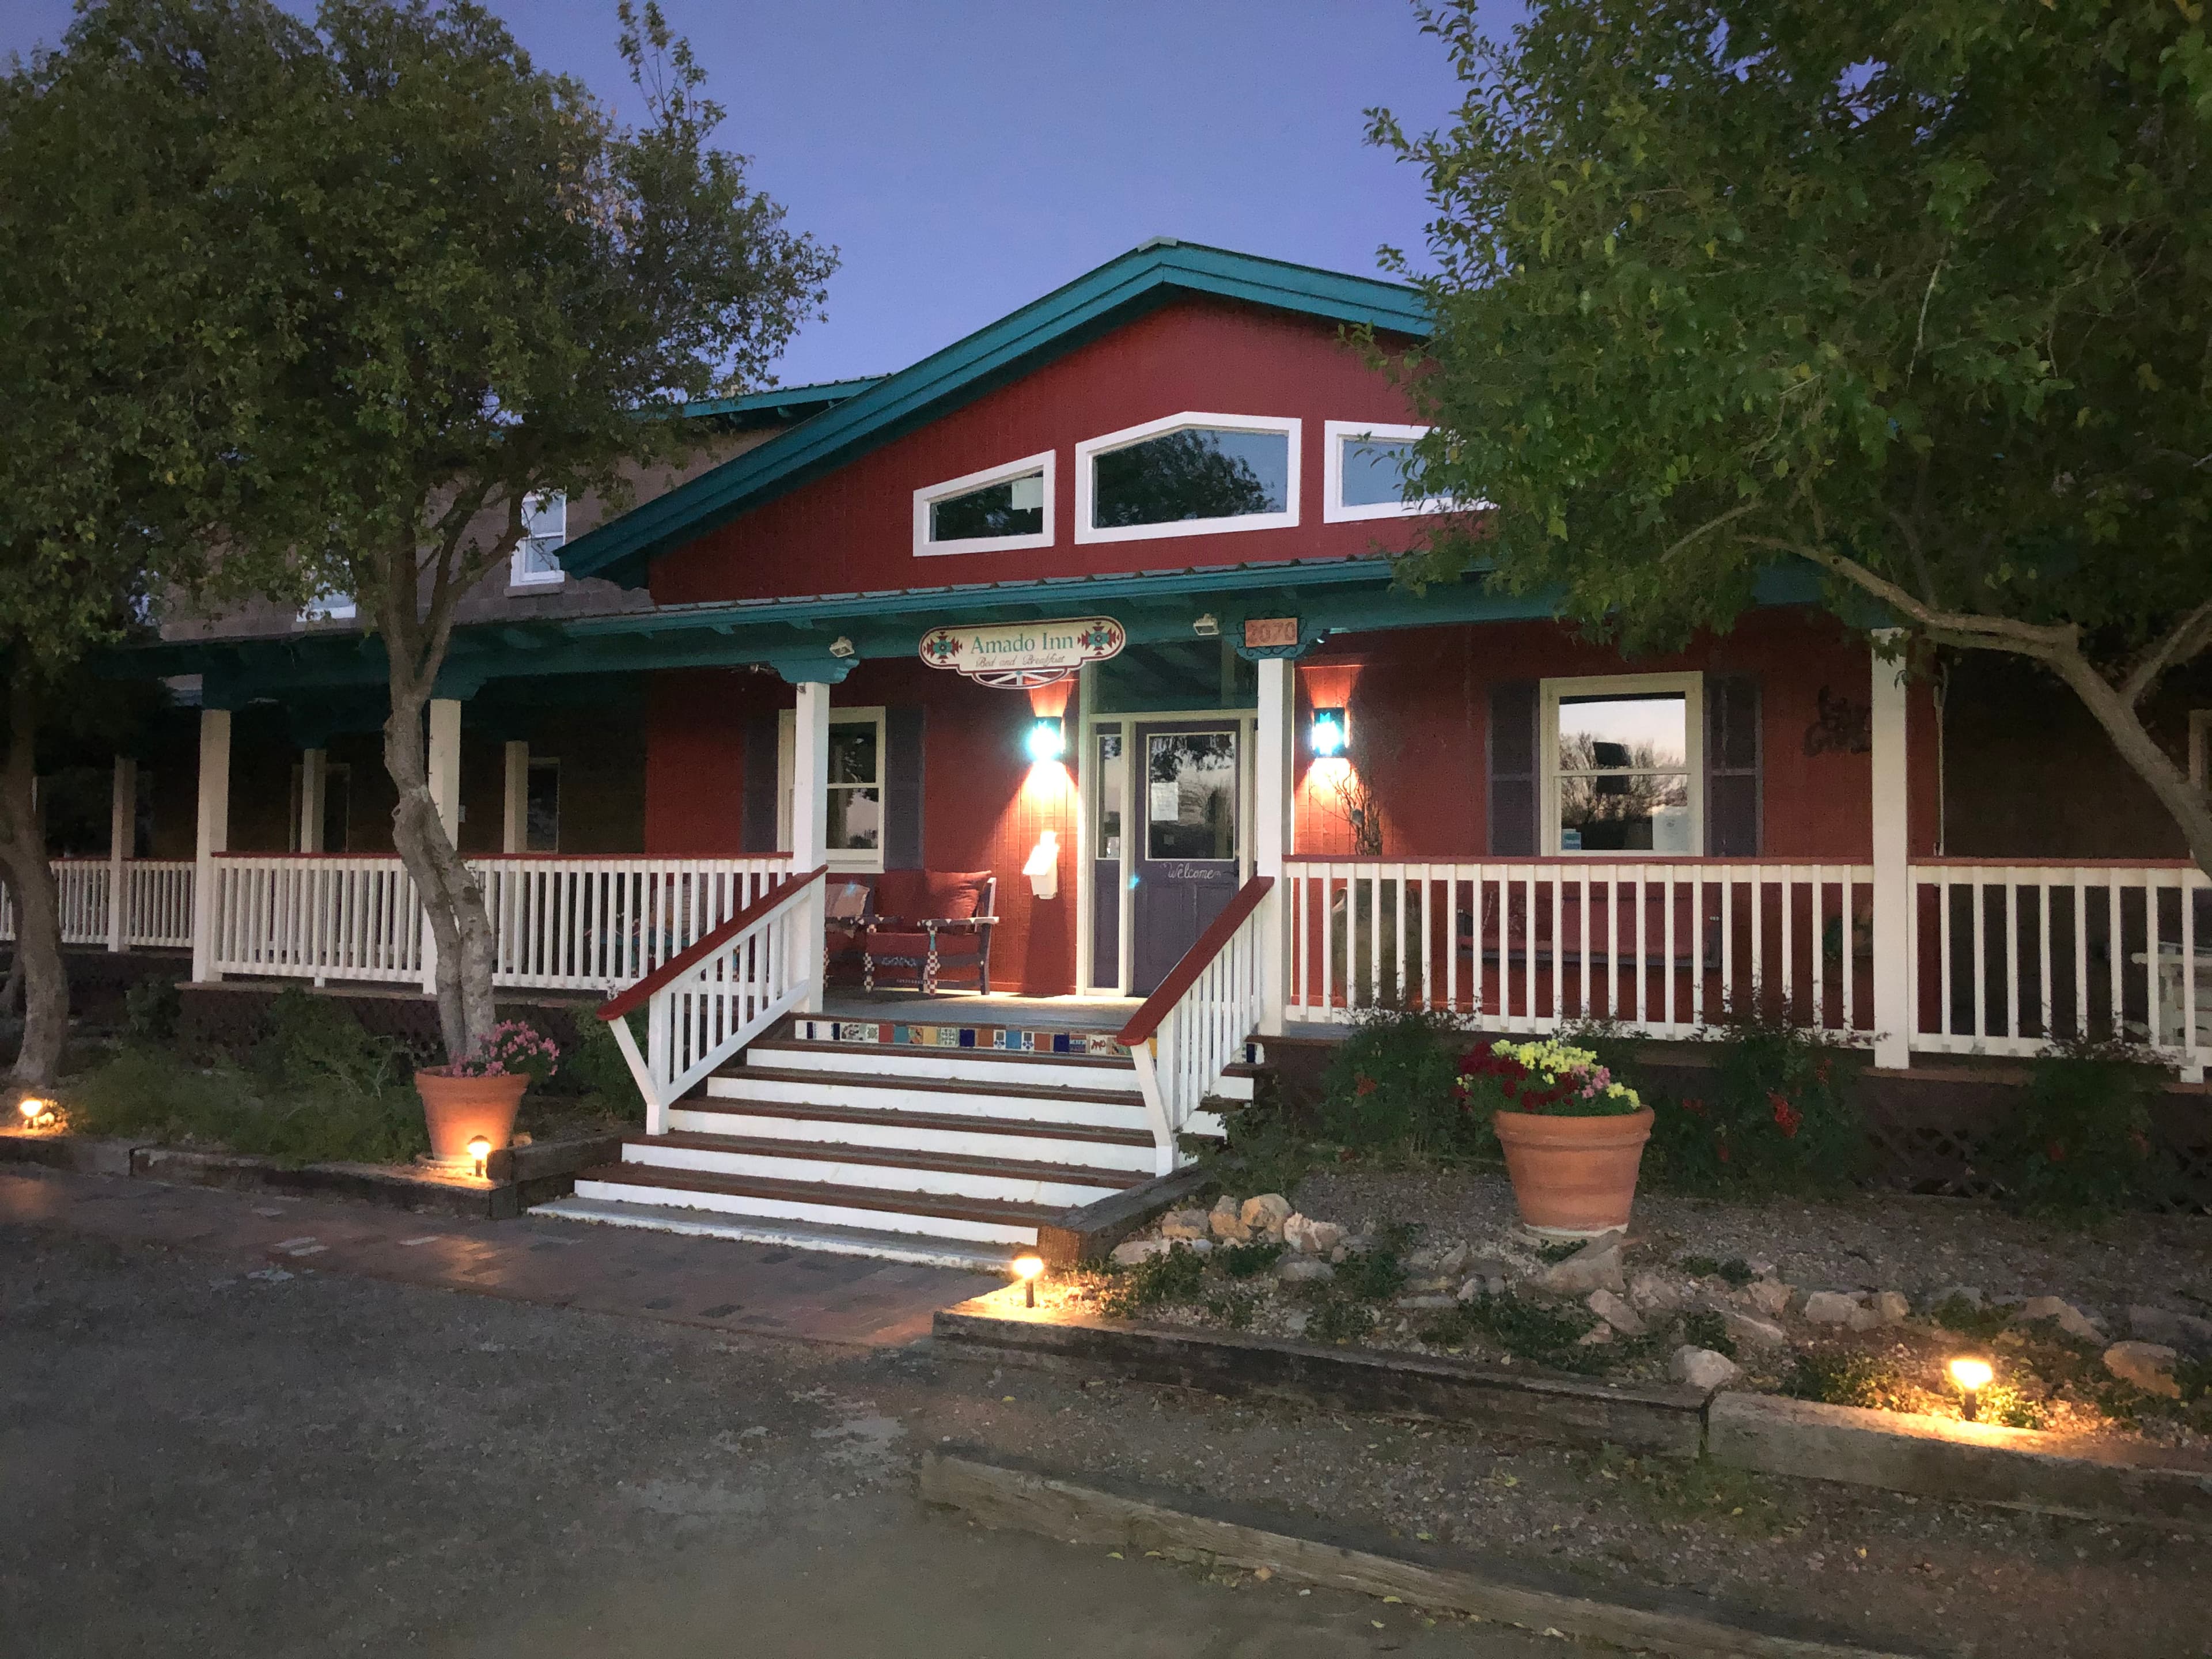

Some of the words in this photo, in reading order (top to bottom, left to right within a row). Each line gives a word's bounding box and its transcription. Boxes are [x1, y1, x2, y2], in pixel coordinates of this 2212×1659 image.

[1247, 622, 1296, 644] 2070
[971, 633, 1035, 654] Amado
[1043, 632, 1073, 650] Inn
[975, 656, 996, 668] Bed
[999, 654, 1017, 666] and
[1022, 653, 1065, 666] Breakfast
[1160, 862, 1221, 879] Welcome
